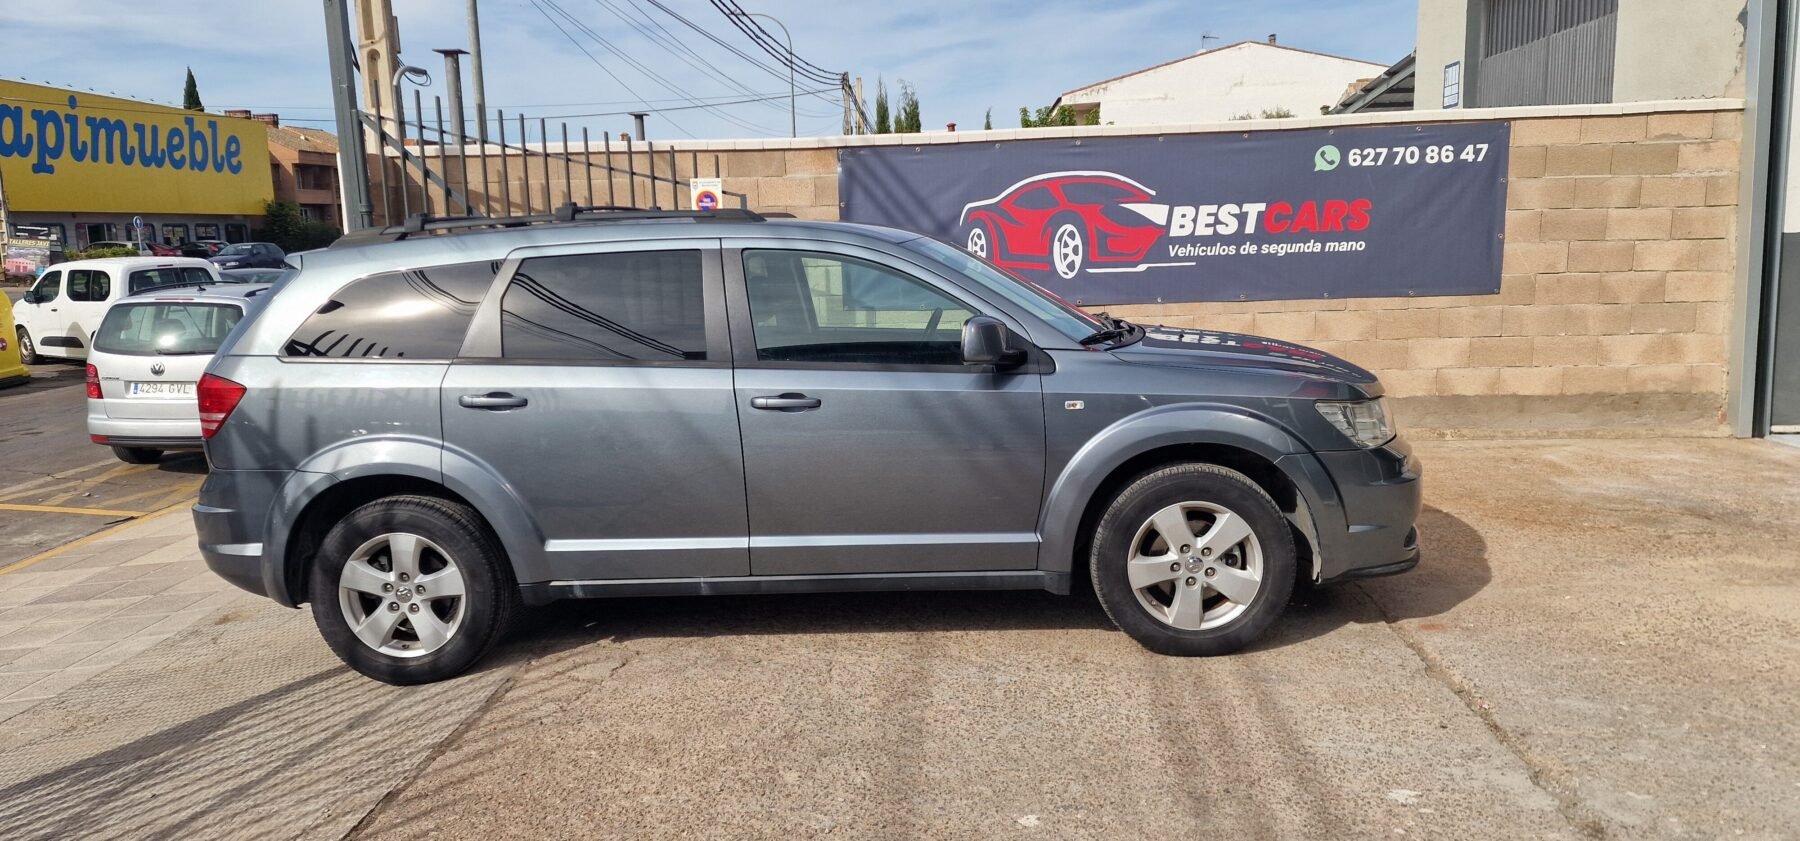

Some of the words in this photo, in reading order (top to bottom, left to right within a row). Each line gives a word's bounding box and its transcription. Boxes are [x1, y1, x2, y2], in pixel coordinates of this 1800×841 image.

[0, 95, 242, 174] apimueble
[1348, 148, 1388, 166] 627
[1392, 147, 1420, 165] 70
[1425, 145, 1454, 164] 86
[1459, 144, 1489, 162] 47
[1168, 243, 1236, 257] Vehículos
[1240, 242, 1258, 255] de
[1261, 240, 1322, 256] segunda
[1325, 240, 1366, 252] mano
[139, 383, 164, 394] 4294
[168, 383, 190, 394] GVL
